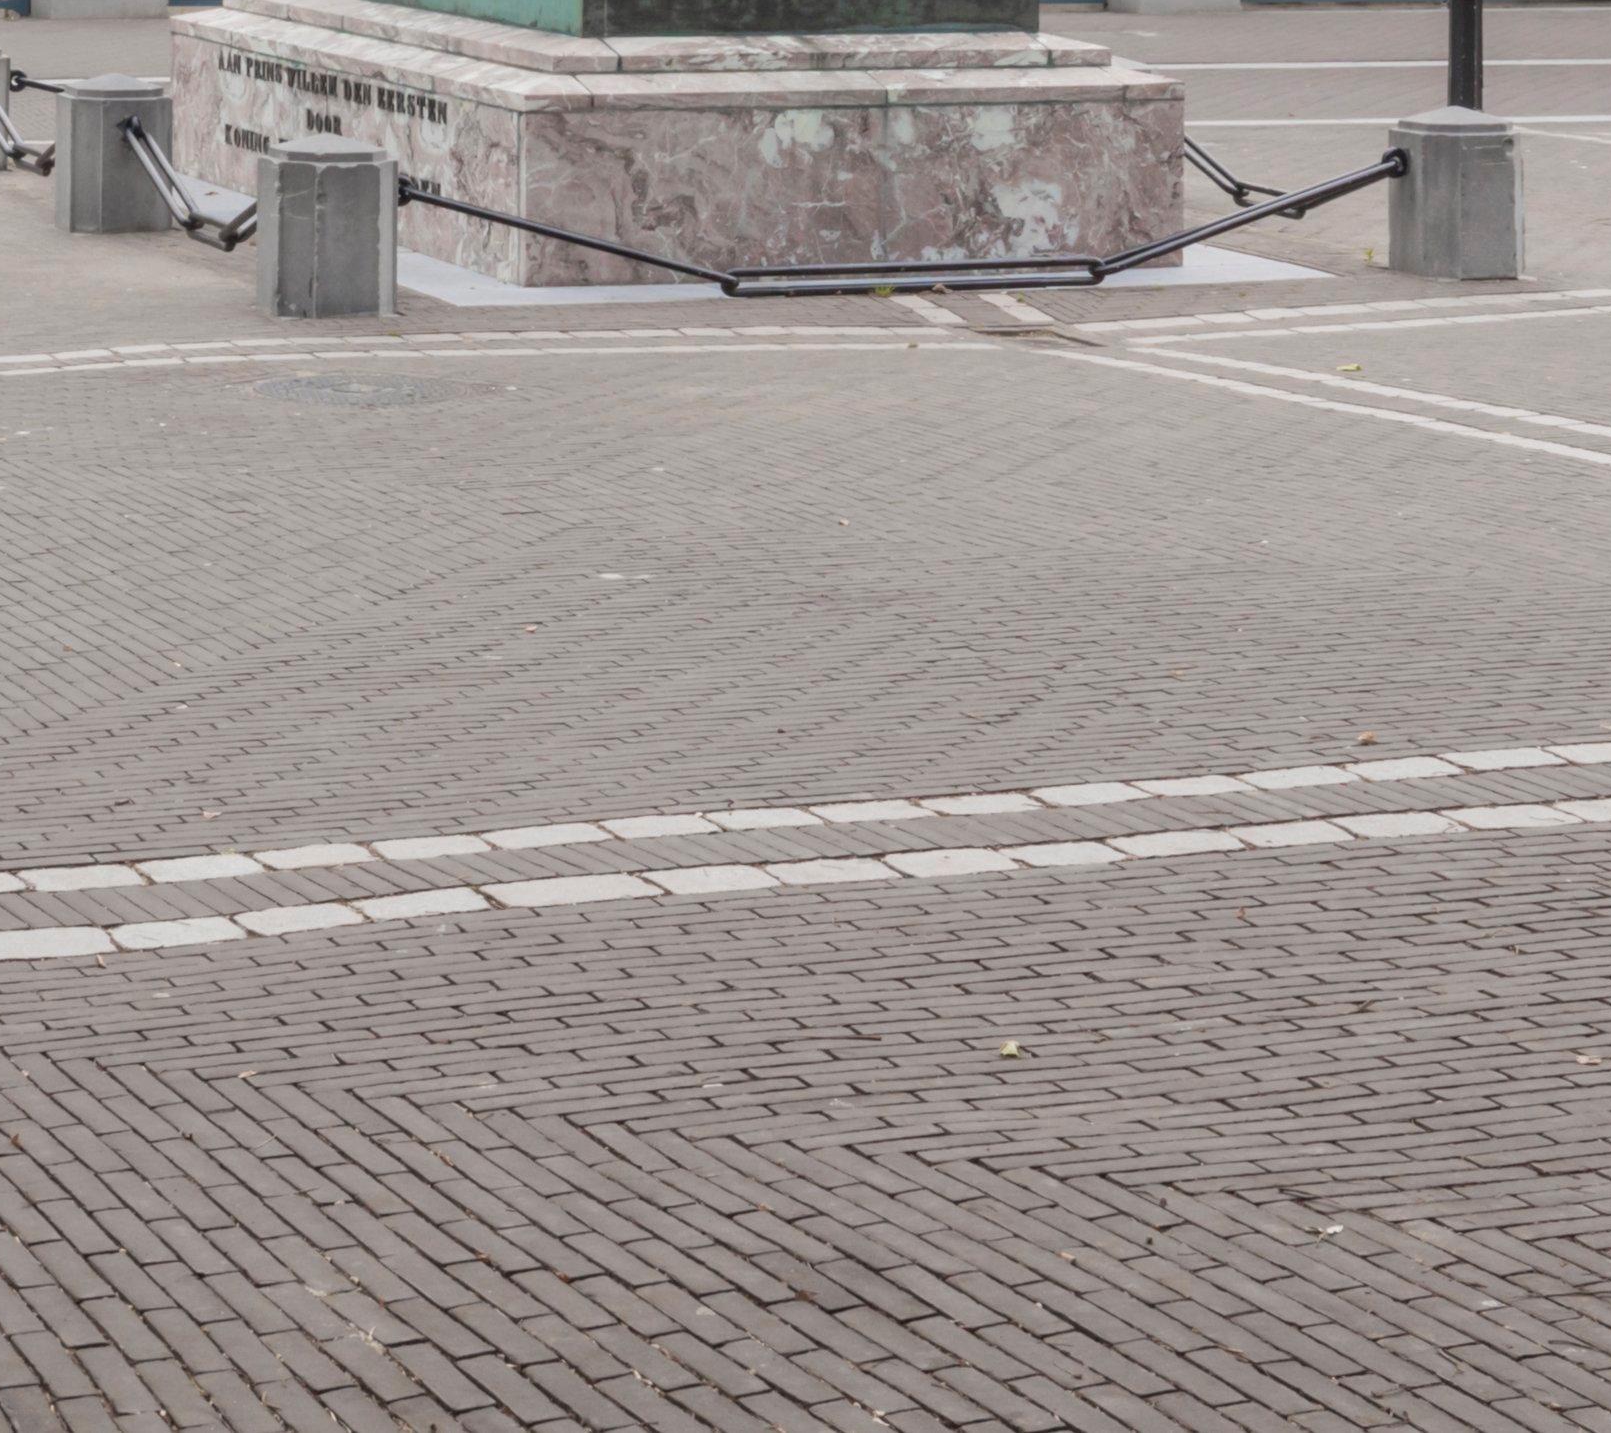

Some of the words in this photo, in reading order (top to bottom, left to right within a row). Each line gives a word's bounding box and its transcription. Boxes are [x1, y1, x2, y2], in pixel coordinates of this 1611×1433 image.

[218, 49, 241, 75] AAN
[246, 56, 282, 84] PRINS
[342, 78, 372, 107] DEN
[377, 87, 448, 125] EERSTEN
[306, 108, 343, 135] DOOR
